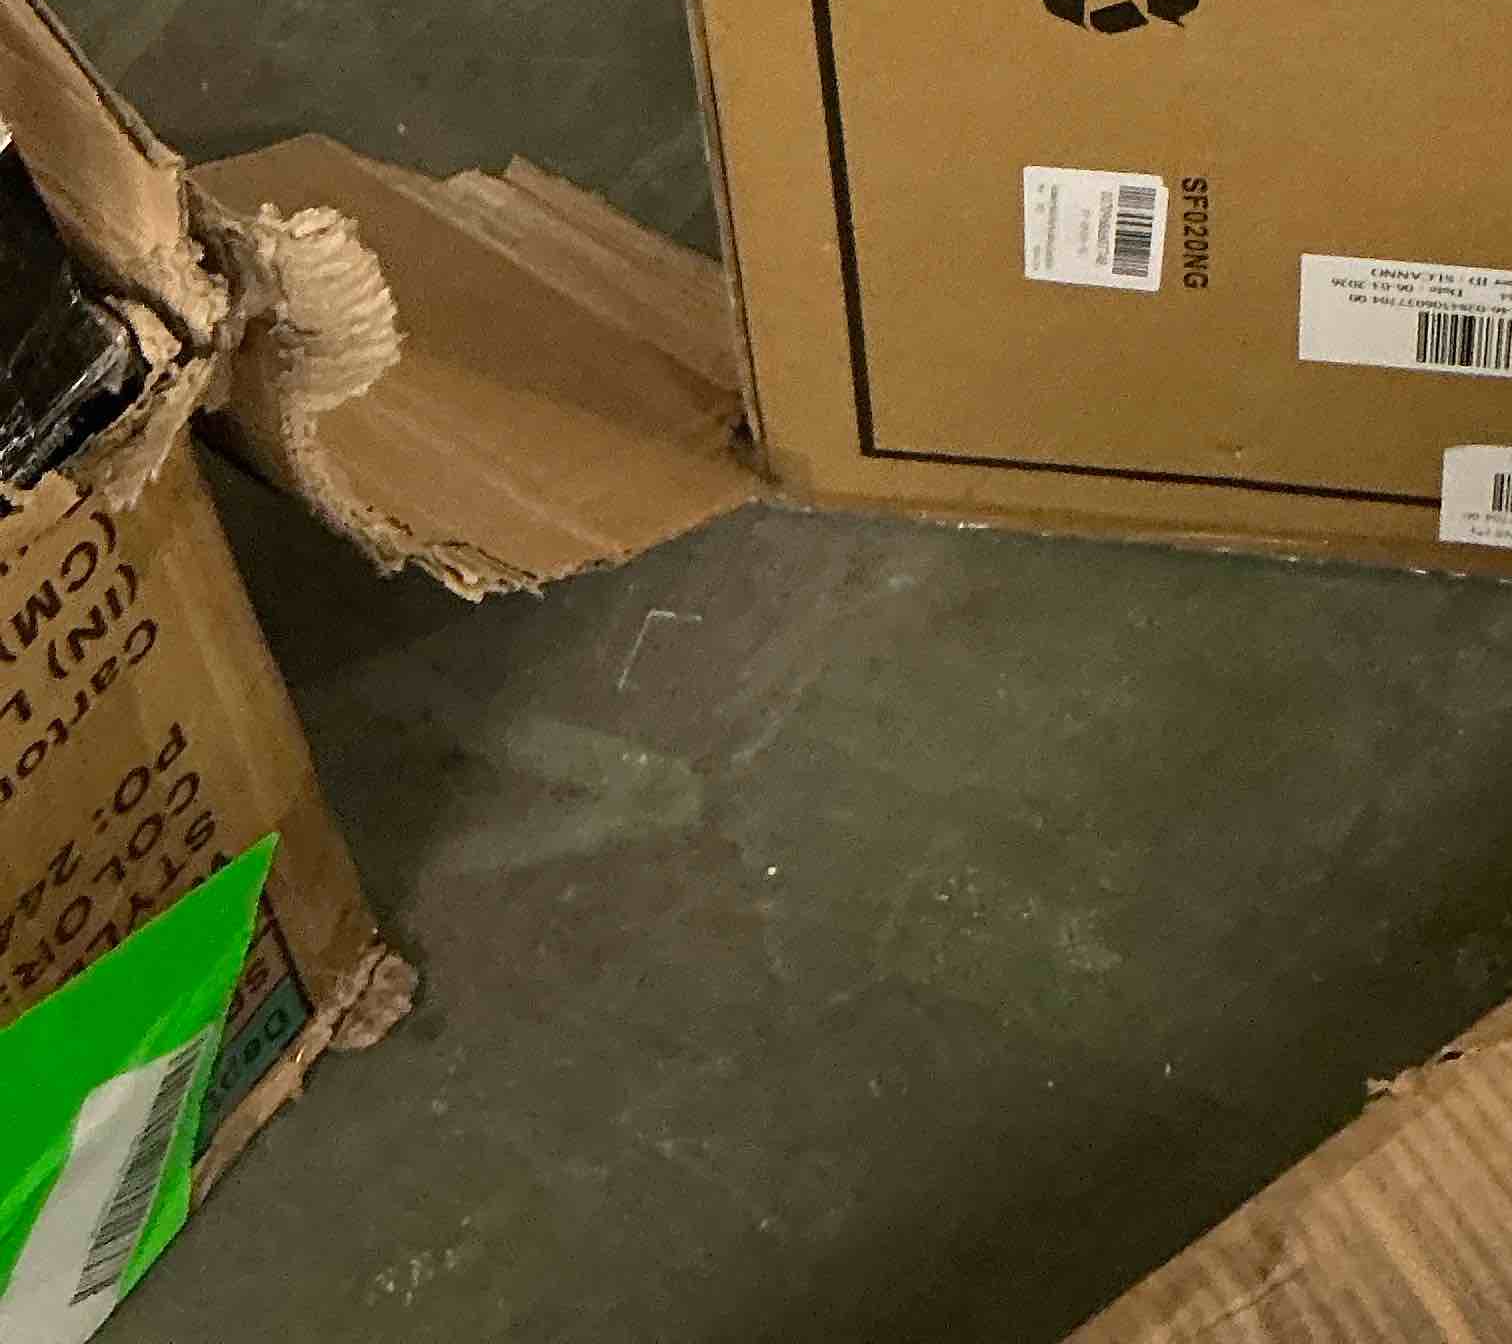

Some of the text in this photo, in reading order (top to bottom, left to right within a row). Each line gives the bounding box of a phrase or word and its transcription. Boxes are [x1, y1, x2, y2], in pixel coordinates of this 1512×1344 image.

[1179, 176, 1210, 291] SF020NG
[48, 564, 137, 680] (IN)
[93, 721, 188, 835] PO:
[64, 810, 216, 980] STYL
